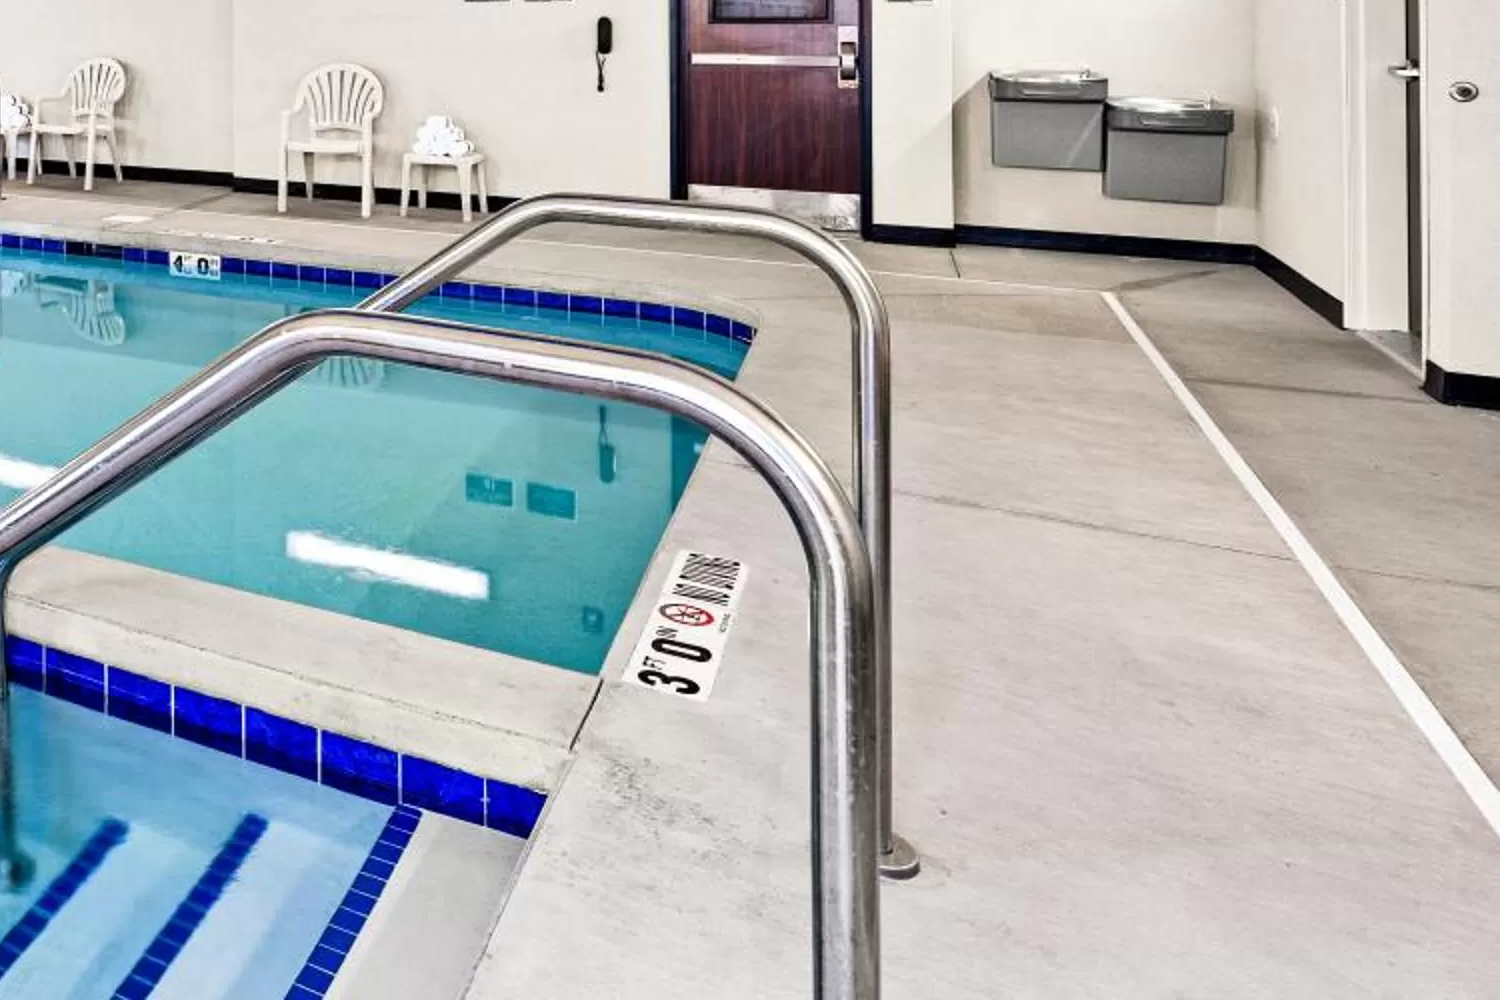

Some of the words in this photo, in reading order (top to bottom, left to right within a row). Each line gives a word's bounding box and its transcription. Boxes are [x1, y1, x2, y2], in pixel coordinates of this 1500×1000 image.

[173, 255, 183, 273] 4
[651, 638, 712, 663] 0
[637, 669, 700, 695] 3
